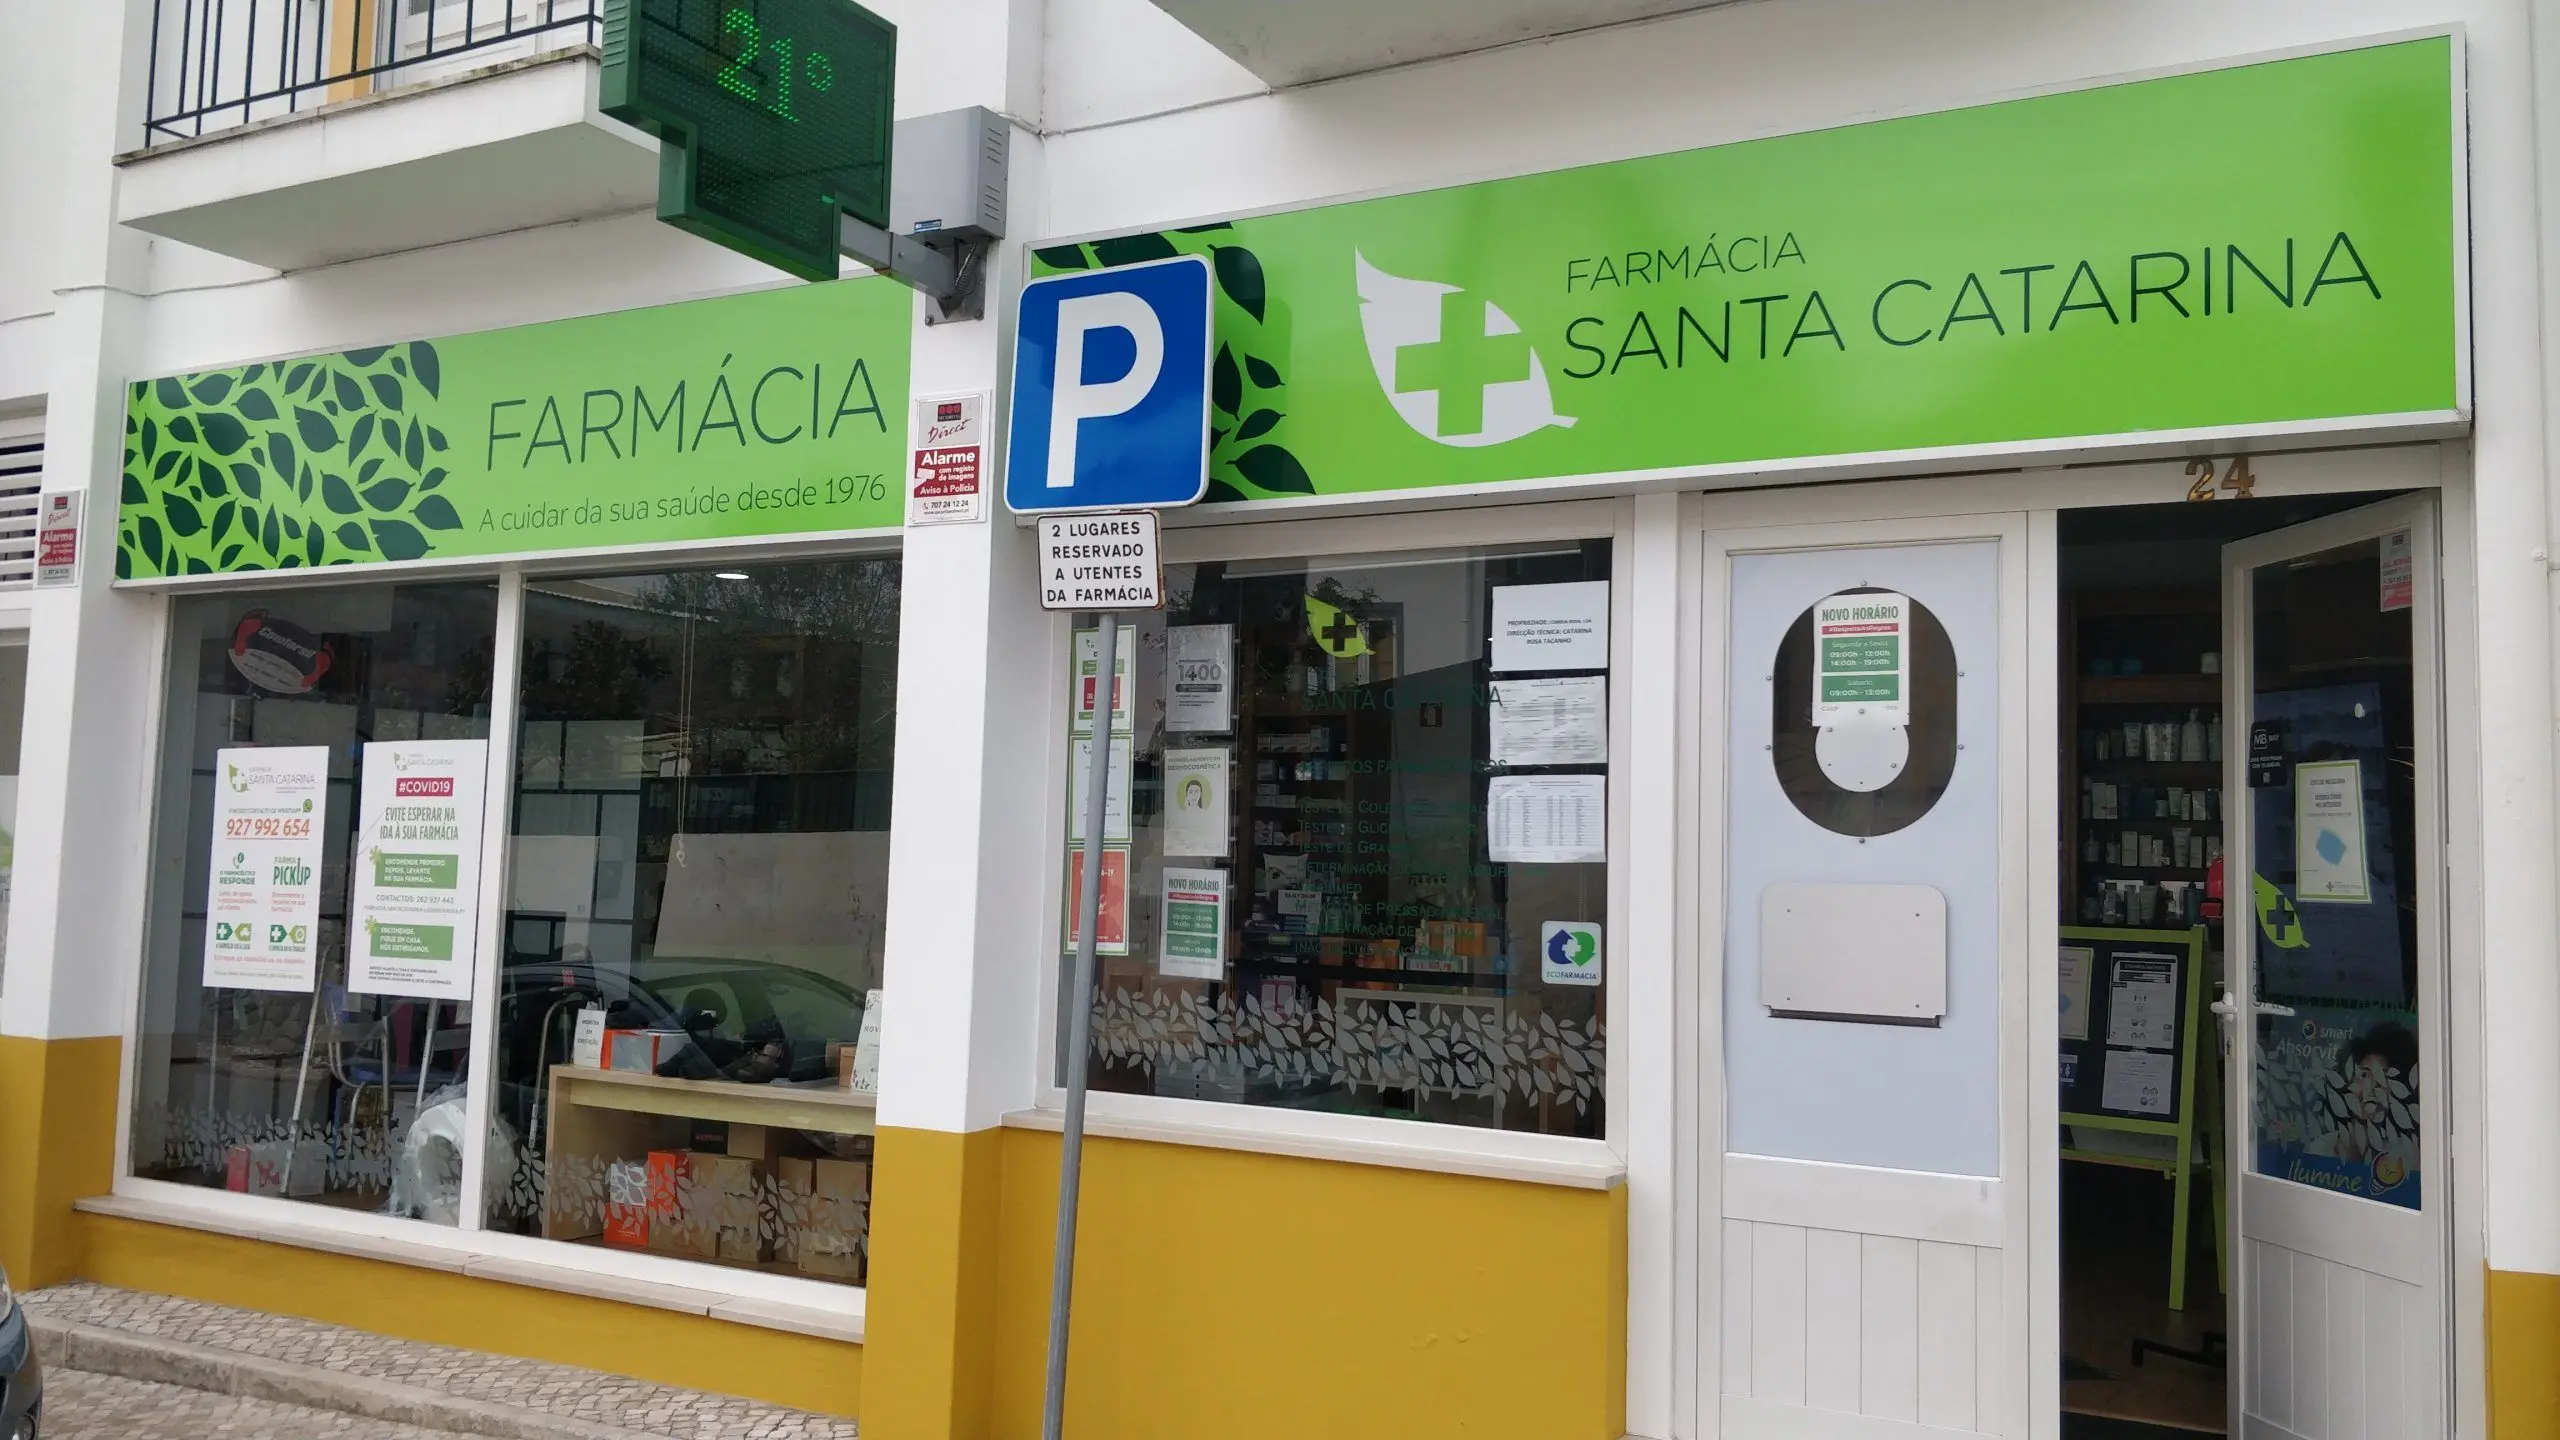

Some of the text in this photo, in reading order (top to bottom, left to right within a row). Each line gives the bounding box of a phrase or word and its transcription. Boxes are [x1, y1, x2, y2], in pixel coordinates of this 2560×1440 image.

[1566, 231, 1807, 294] FARMÁCIA
[1562, 231, 2383, 379] SANTA CATARINA
[1046, 291, 1165, 488] P
[487, 353, 887, 472] FARMÁCIA
[921, 450, 976, 466] Alarme
[948, 473, 975, 482] imagens
[953, 465, 975, 474] registo
[2184, 455, 2256, 501] 24
[920, 483, 975, 495] Aviso à Polícia
[479, 473, 887, 532] A cuidar da sua saúde desde 1976
[930, 501, 942, 509] 707
[1052, 521, 1141, 538] 2 LUGARES
[1052, 543, 1144, 560] RESERVADO
[1055, 565, 1143, 581] A UTENTES
[1047, 584, 1154, 603] DA FARMÁCIA
[1821, 604, 1899, 622] NOVO HORÁRIO
[1178, 664, 1222, 682] 1400
[398, 781, 451, 793] #COVID19
[385, 806, 456, 822] EVITE ESPERAR NA
[226, 818, 310, 836] 927 992 654
[380, 822, 459, 840] IDA À SUA FARMÁCIA
[219, 877, 256, 885] RESPONDE
[273, 865, 311, 886] PICKUP
[1168, 877, 1219, 892] NOVO HORÁRIO
[1546, 971, 1597, 980] ECOFARMÁCIA
[2320, 1027, 2353, 1041] smart
